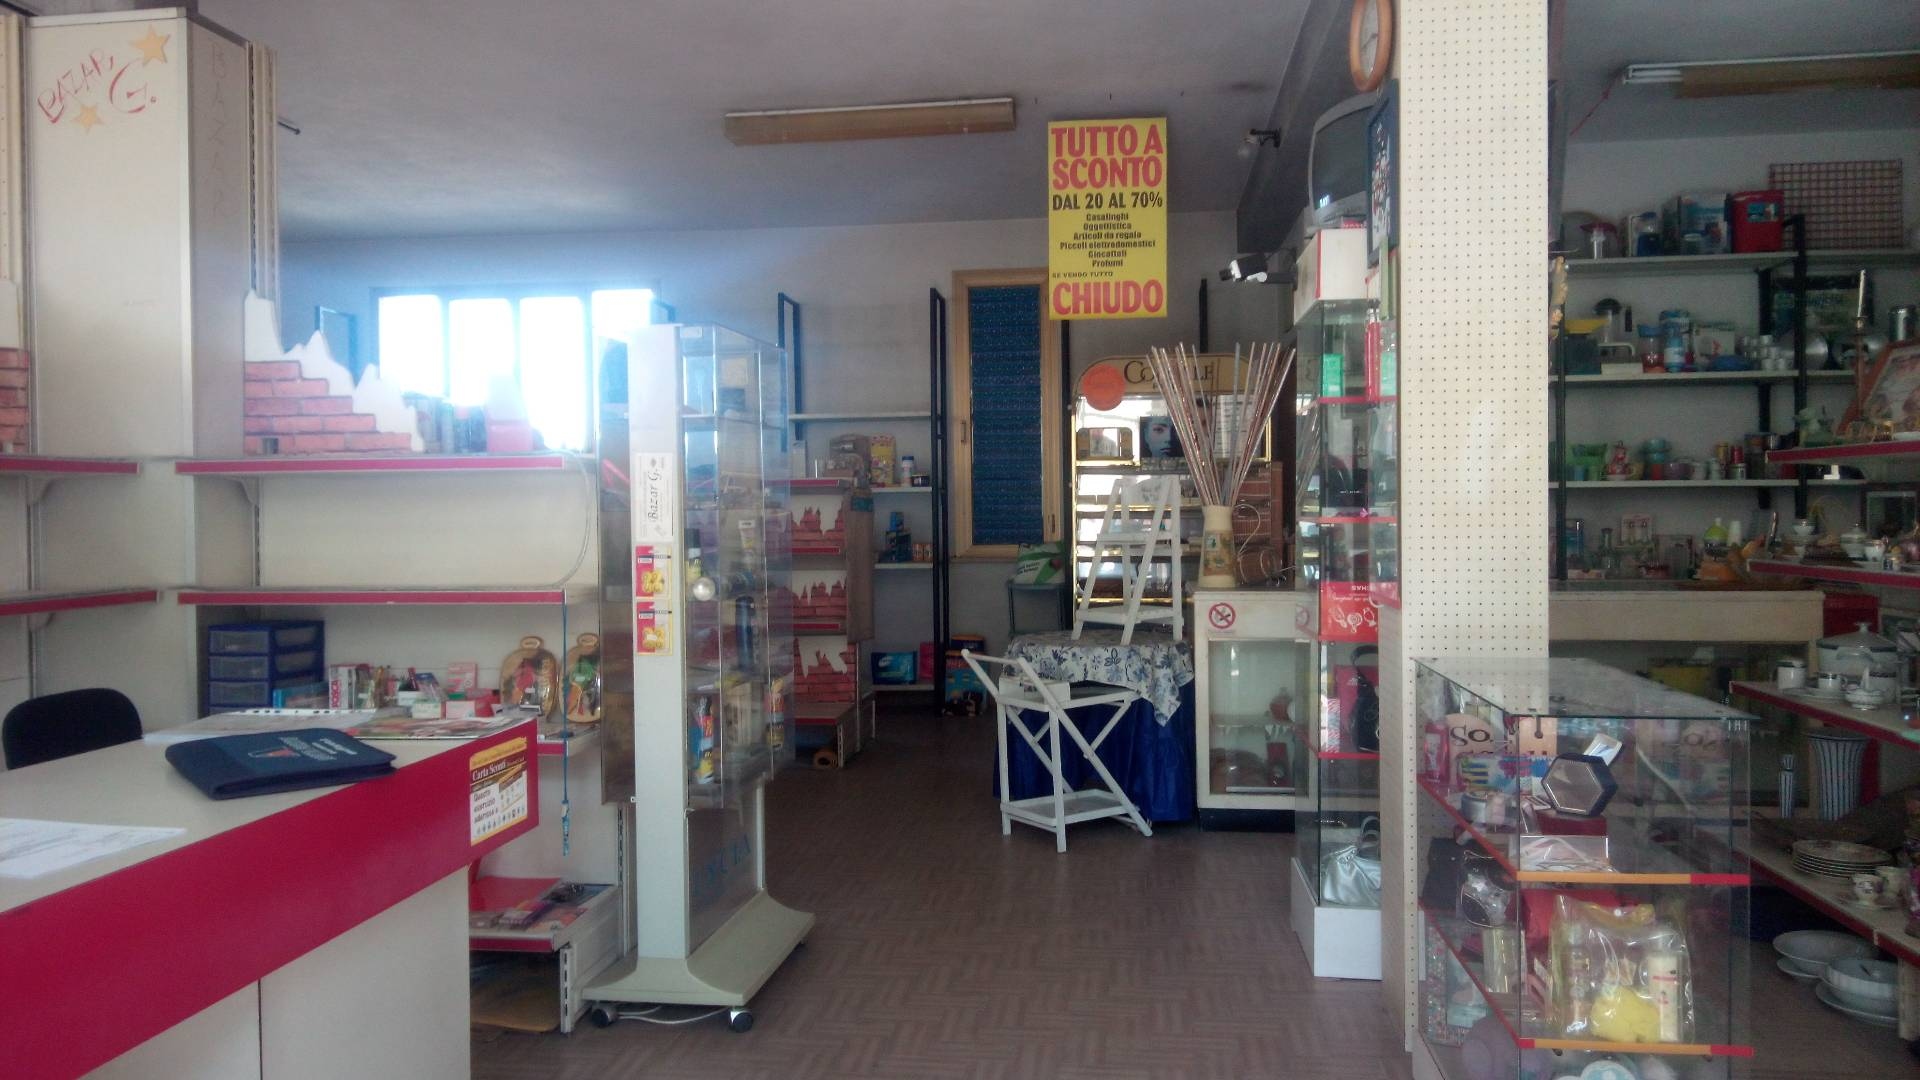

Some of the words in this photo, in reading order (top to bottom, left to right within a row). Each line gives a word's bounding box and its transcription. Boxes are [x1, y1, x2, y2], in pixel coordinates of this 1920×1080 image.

[1051, 124, 1138, 158] TUTTO
[1143, 124, 1163, 155] A
[1052, 156, 1163, 190] SCONTO
[1052, 193, 1080, 211] DAL
[1085, 193, 1103, 209] 20
[1108, 192, 1126, 208] AL
[1131, 191, 1163, 208] 70%
[1086, 212, 1129, 222] Casalinghi
[1083, 222, 1132, 232] Oggettistica
[1073, 231, 1102, 241] Articoli
[1104, 232, 1114, 240] da
[1115, 231, 1142, 241] regalo
[1060, 241, 1087, 250] Piccoli
[1089, 239, 1156, 249] elettrodomestici
[1088, 250, 1127, 259] Giocattoli
[1092, 259, 1123, 268] Profumi
[1052, 279, 1163, 316] CHIUDO
[648, 484, 659, 521] Bazar
[472, 767, 489, 781] Carta
